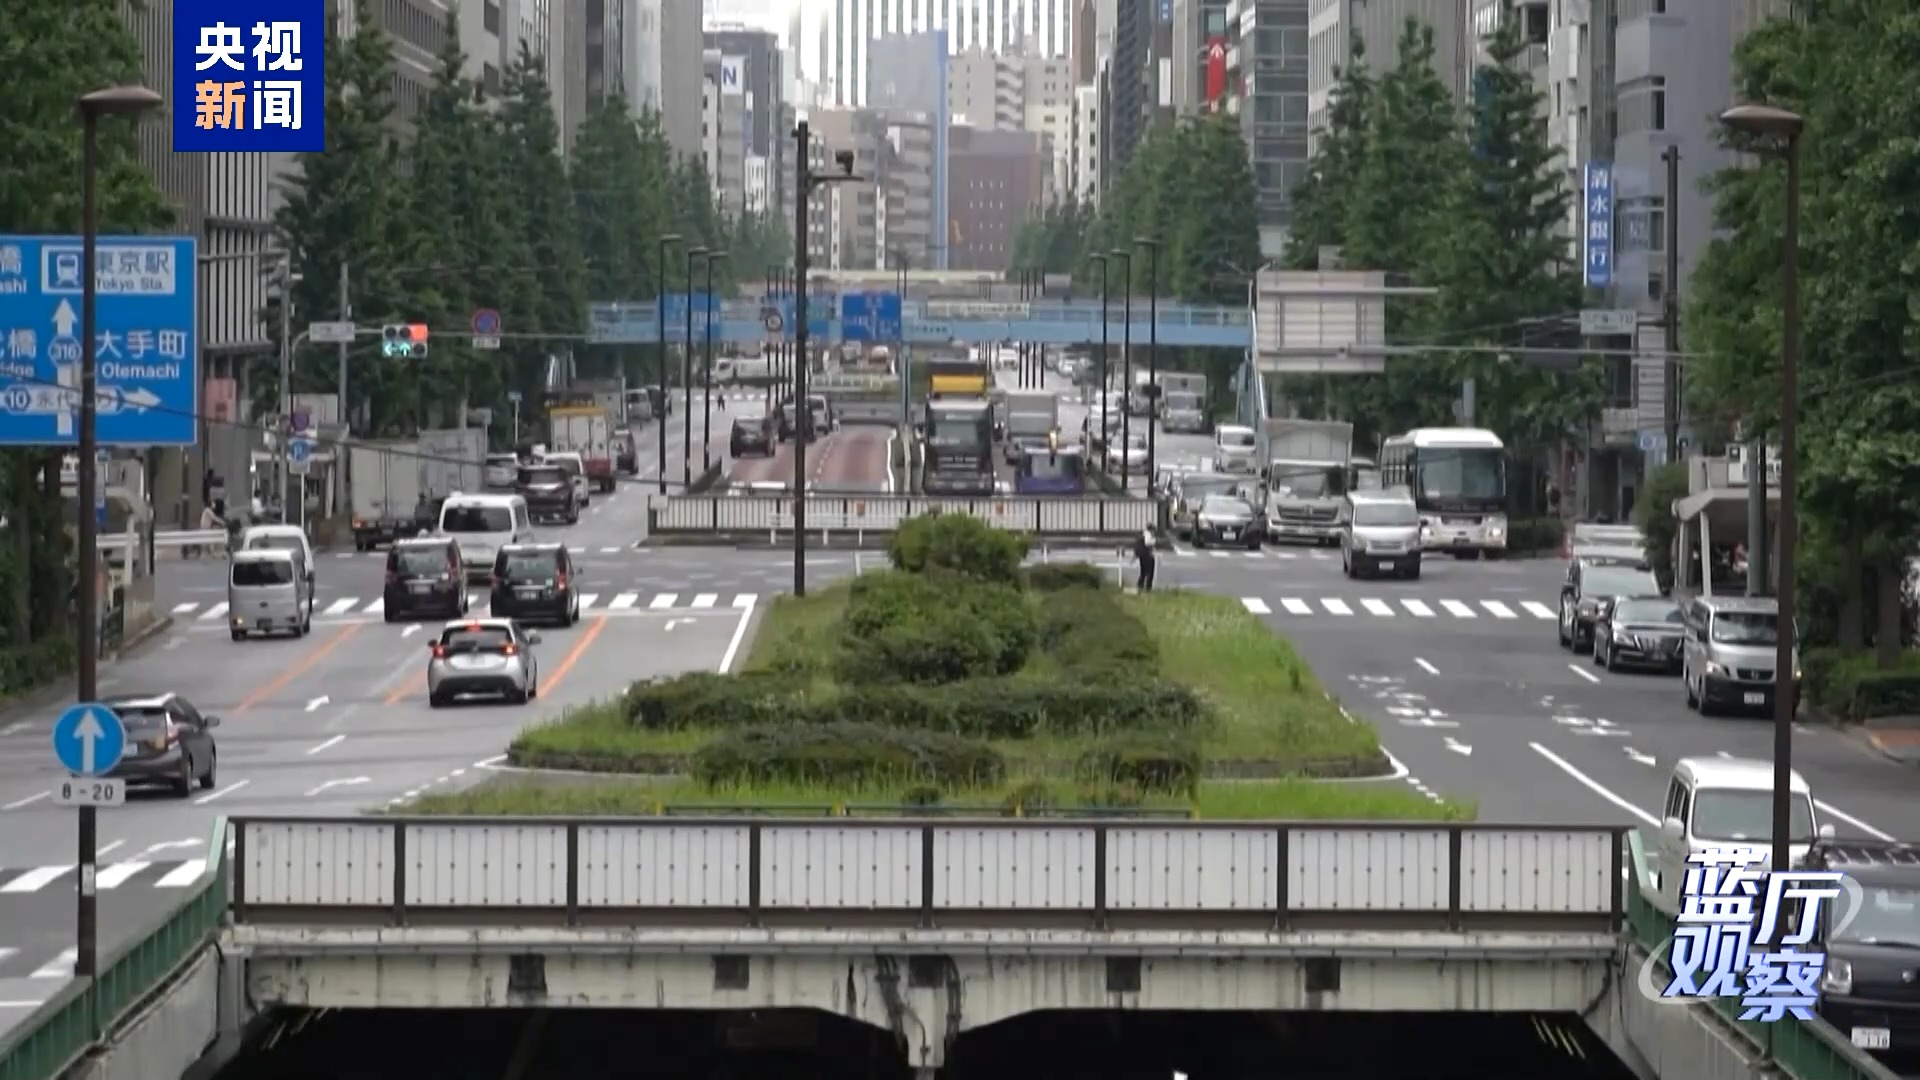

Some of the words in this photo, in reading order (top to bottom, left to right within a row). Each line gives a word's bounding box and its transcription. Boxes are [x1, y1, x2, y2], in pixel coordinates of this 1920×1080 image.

[723, 66, 737, 86] N
[96, 251, 170, 275] 東京駅
[96, 329, 188, 359] 大手町
[102, 362, 180, 379] Otemachi
[9, 390, 27, 409] 10
